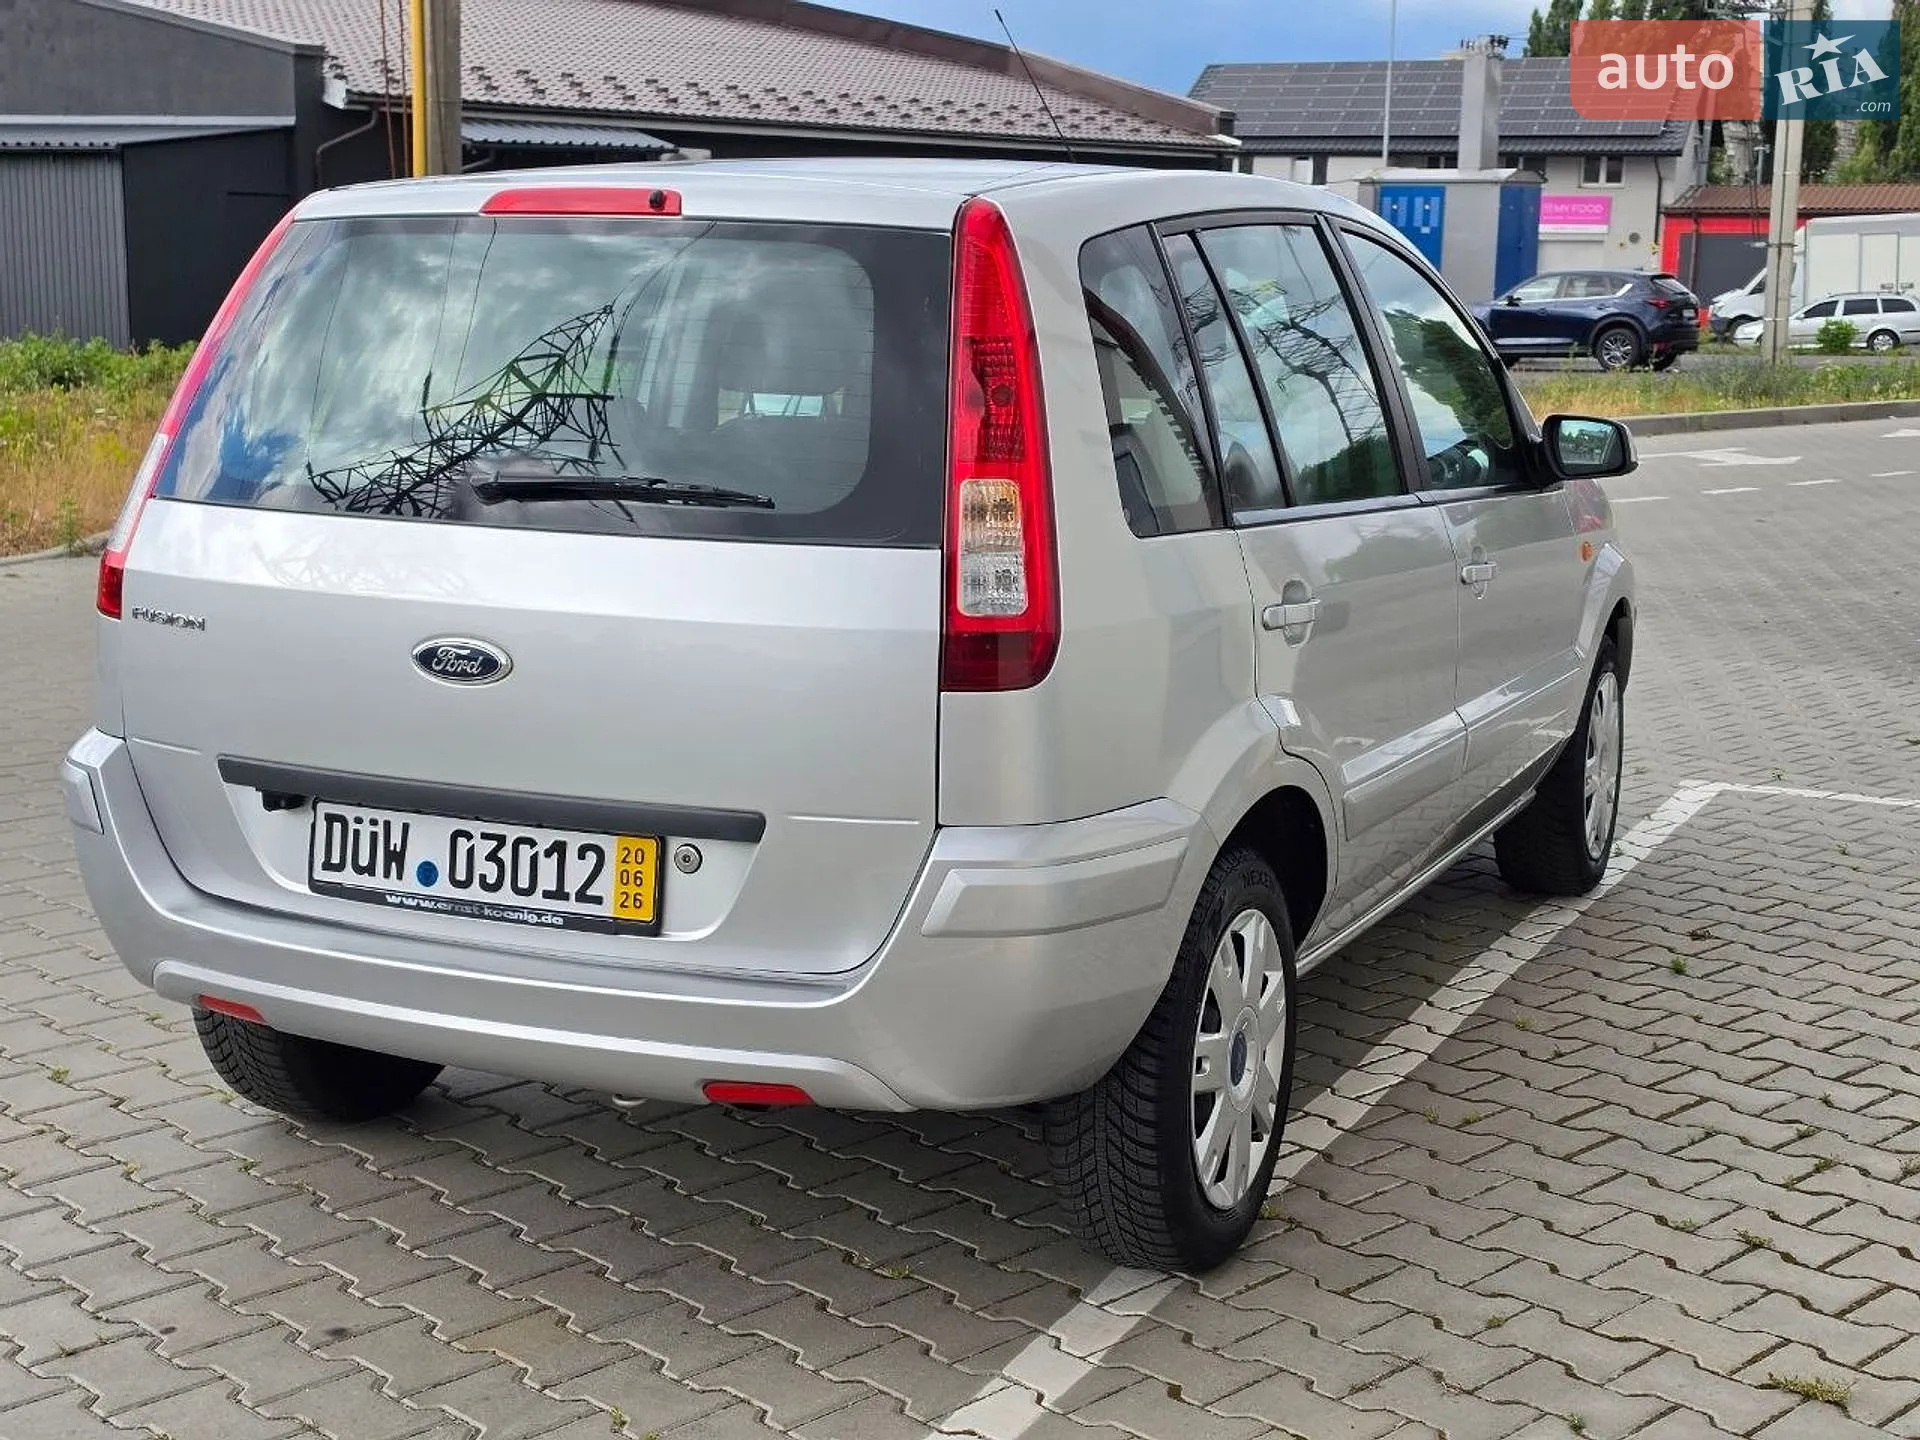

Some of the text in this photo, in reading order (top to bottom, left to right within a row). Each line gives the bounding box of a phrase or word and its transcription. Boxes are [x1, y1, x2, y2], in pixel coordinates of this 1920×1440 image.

[131, 607, 206, 631] FUSION
[431, 646, 485, 674] Ford
[620, 846, 646, 866] 20
[448, 829, 606, 906] 03012
[619, 869, 644, 887] 06
[618, 891, 643, 910] 26
